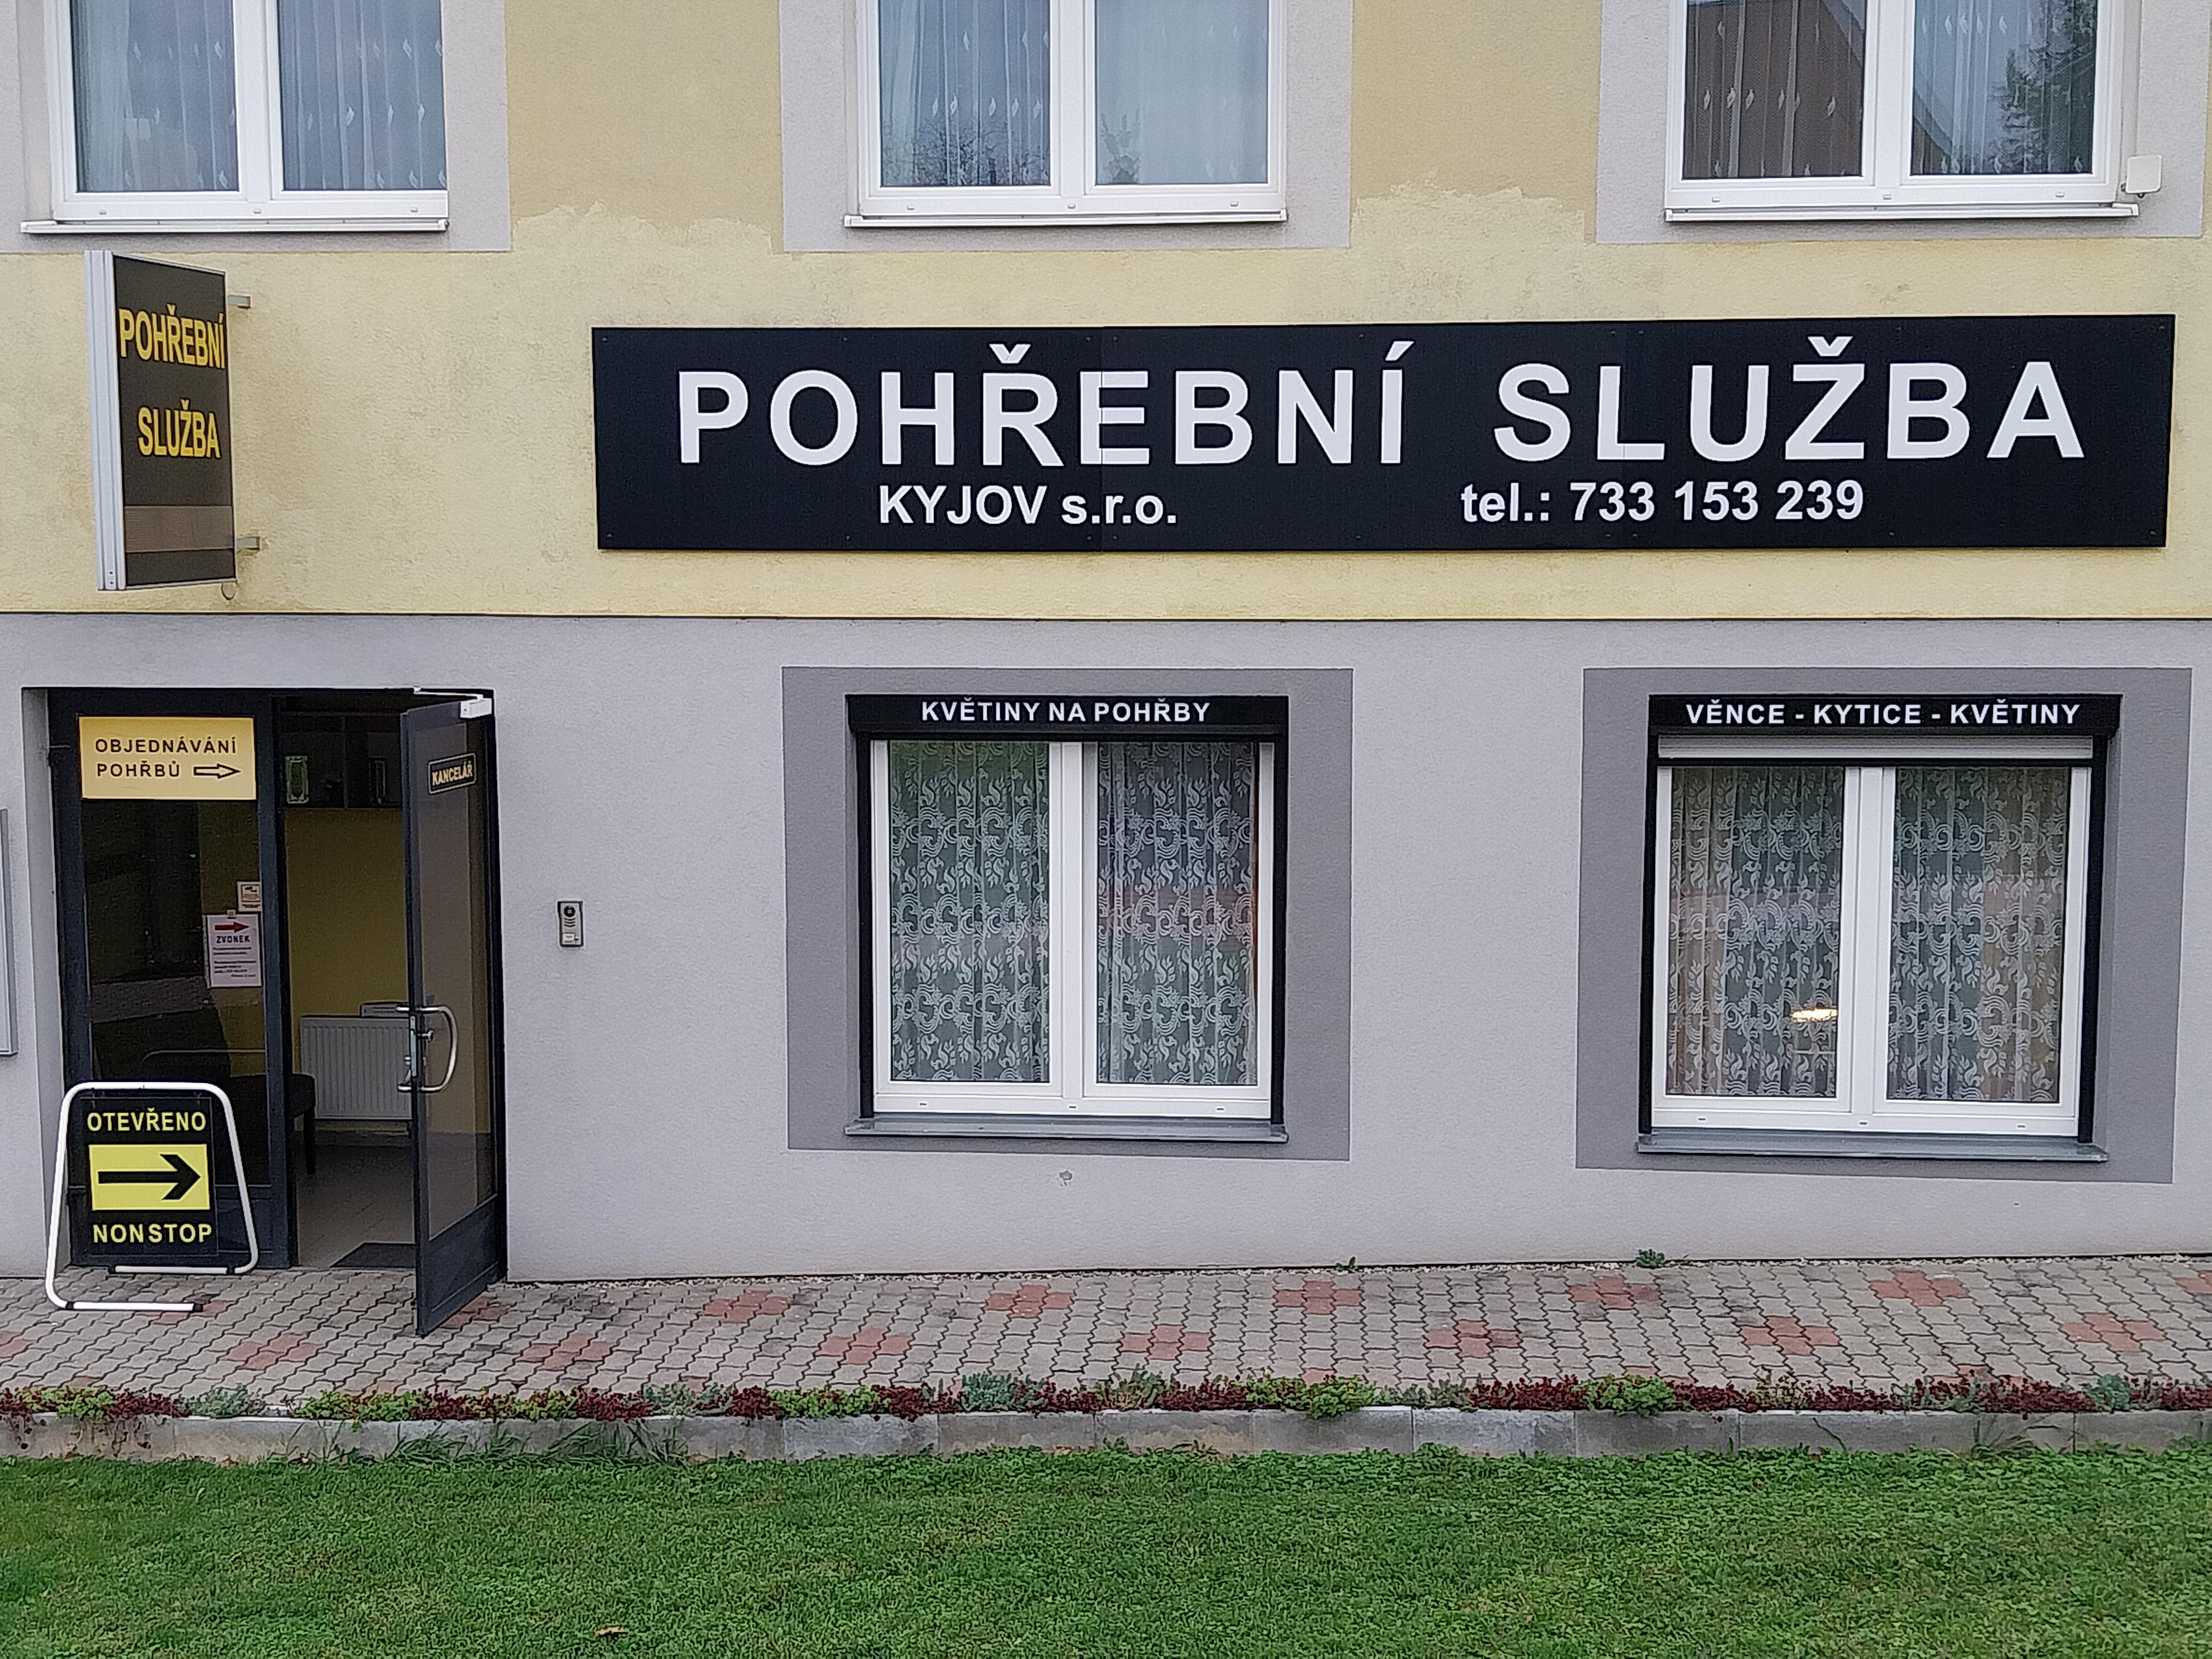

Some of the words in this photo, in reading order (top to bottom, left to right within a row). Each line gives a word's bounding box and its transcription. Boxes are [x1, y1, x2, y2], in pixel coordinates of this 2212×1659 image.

[118, 303, 226, 369] POHŘEBNÍ
[678, 340, 1415, 467] POHŘEBNÍ
[1493, 336, 2085, 462] SLUŽBA
[138, 398, 221, 458] SLUŽBA
[879, 484, 1048, 525] KYJOV
[1061, 494, 1177, 525] s.r.o.
[1460, 482, 1550, 523] tel.:
[1569, 481, 1655, 522] 733
[1674, 480, 1759, 521] 153
[1775, 479, 1864, 520] 239
[922, 697, 1041, 722] KVĚTINY
[1048, 702, 1087, 722] NA
[1094, 697, 1211, 722] POHŘBY
[1685, 698, 1785, 724] VĚNCE
[1814, 703, 1922, 724] KYTICE
[1950, 698, 2081, 724] KVĚTINY
[95, 735, 237, 754] OBJEDNÁVÁNÍ
[96, 760, 180, 778] POHŘBŮ
[216, 935, 251, 944] ZVONEK
[87, 1107, 207, 1132] OTEVŘENO
[93, 1223, 212, 1244] NONSTOP
